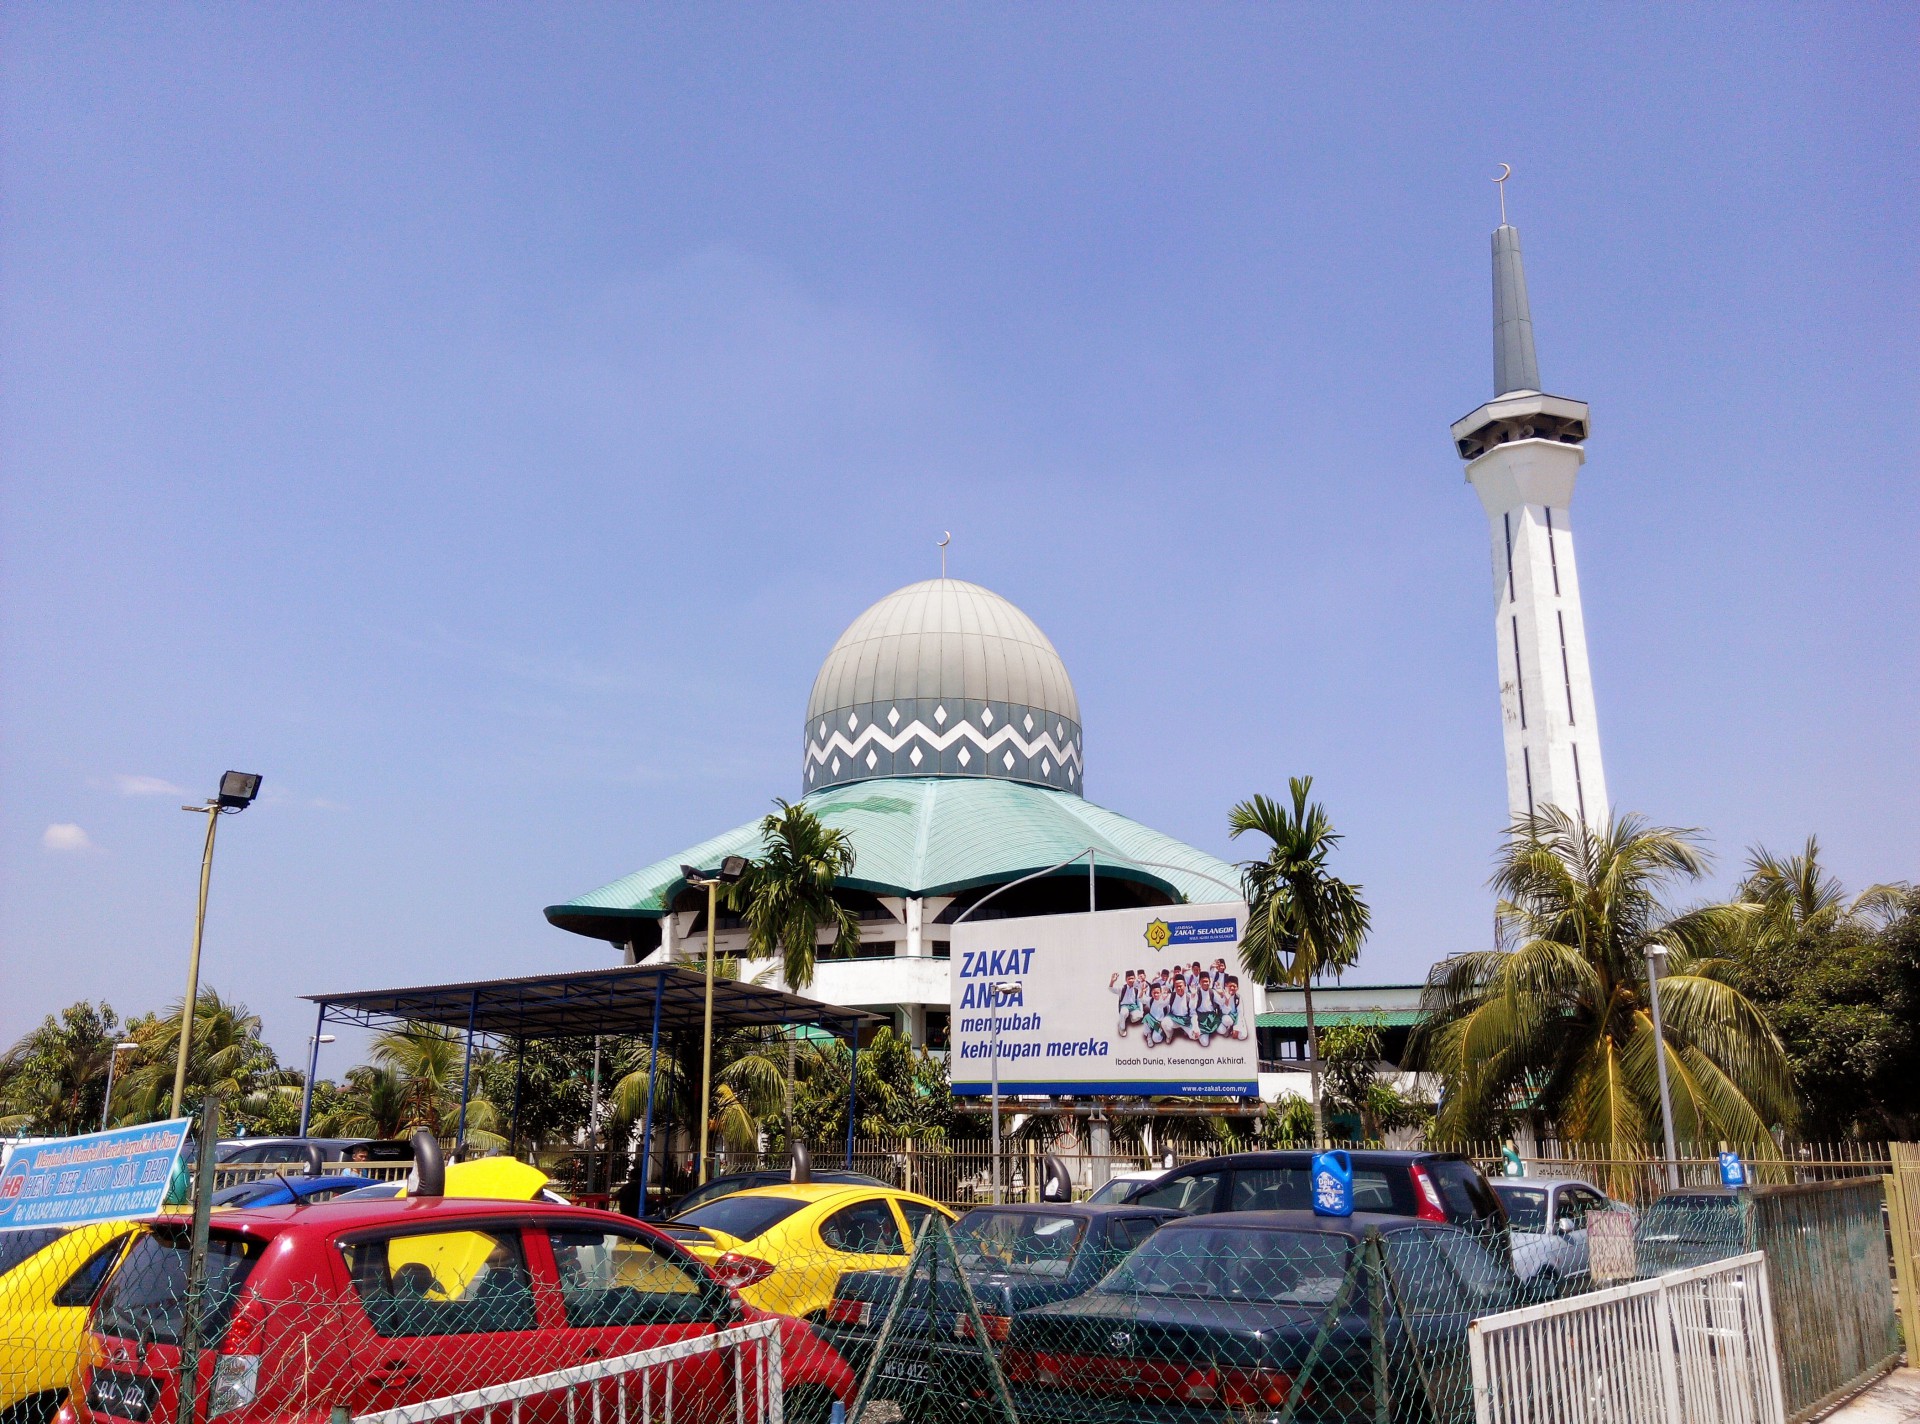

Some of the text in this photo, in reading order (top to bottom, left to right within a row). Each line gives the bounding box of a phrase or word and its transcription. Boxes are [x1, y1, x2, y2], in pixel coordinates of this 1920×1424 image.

[1173, 929, 1197, 937] ZAKAT
[1197, 926, 1234, 935] SELANGOR
[960, 948, 1035, 977] ZAKAT
[960, 981, 1023, 1009] ANDA
[960, 1012, 1041, 1035] mengubah
[960, 1038, 1109, 1061] kehidupan mereka
[1115, 1057, 1247, 1067] Ibadah Dunia, Kesenangan Akhirat.
[1181, 1085, 1247, 1093] www.e-zakat.com.my
[159, 1131, 180, 1150] Baru
[1, 1175, 24, 1198] HB
[22, 1173, 56, 1199] HENG
[54, 1170, 80, 1195] BEE
[77, 1166, 113, 1193] AUTO
[139, 1157, 169, 1185] BHD.
